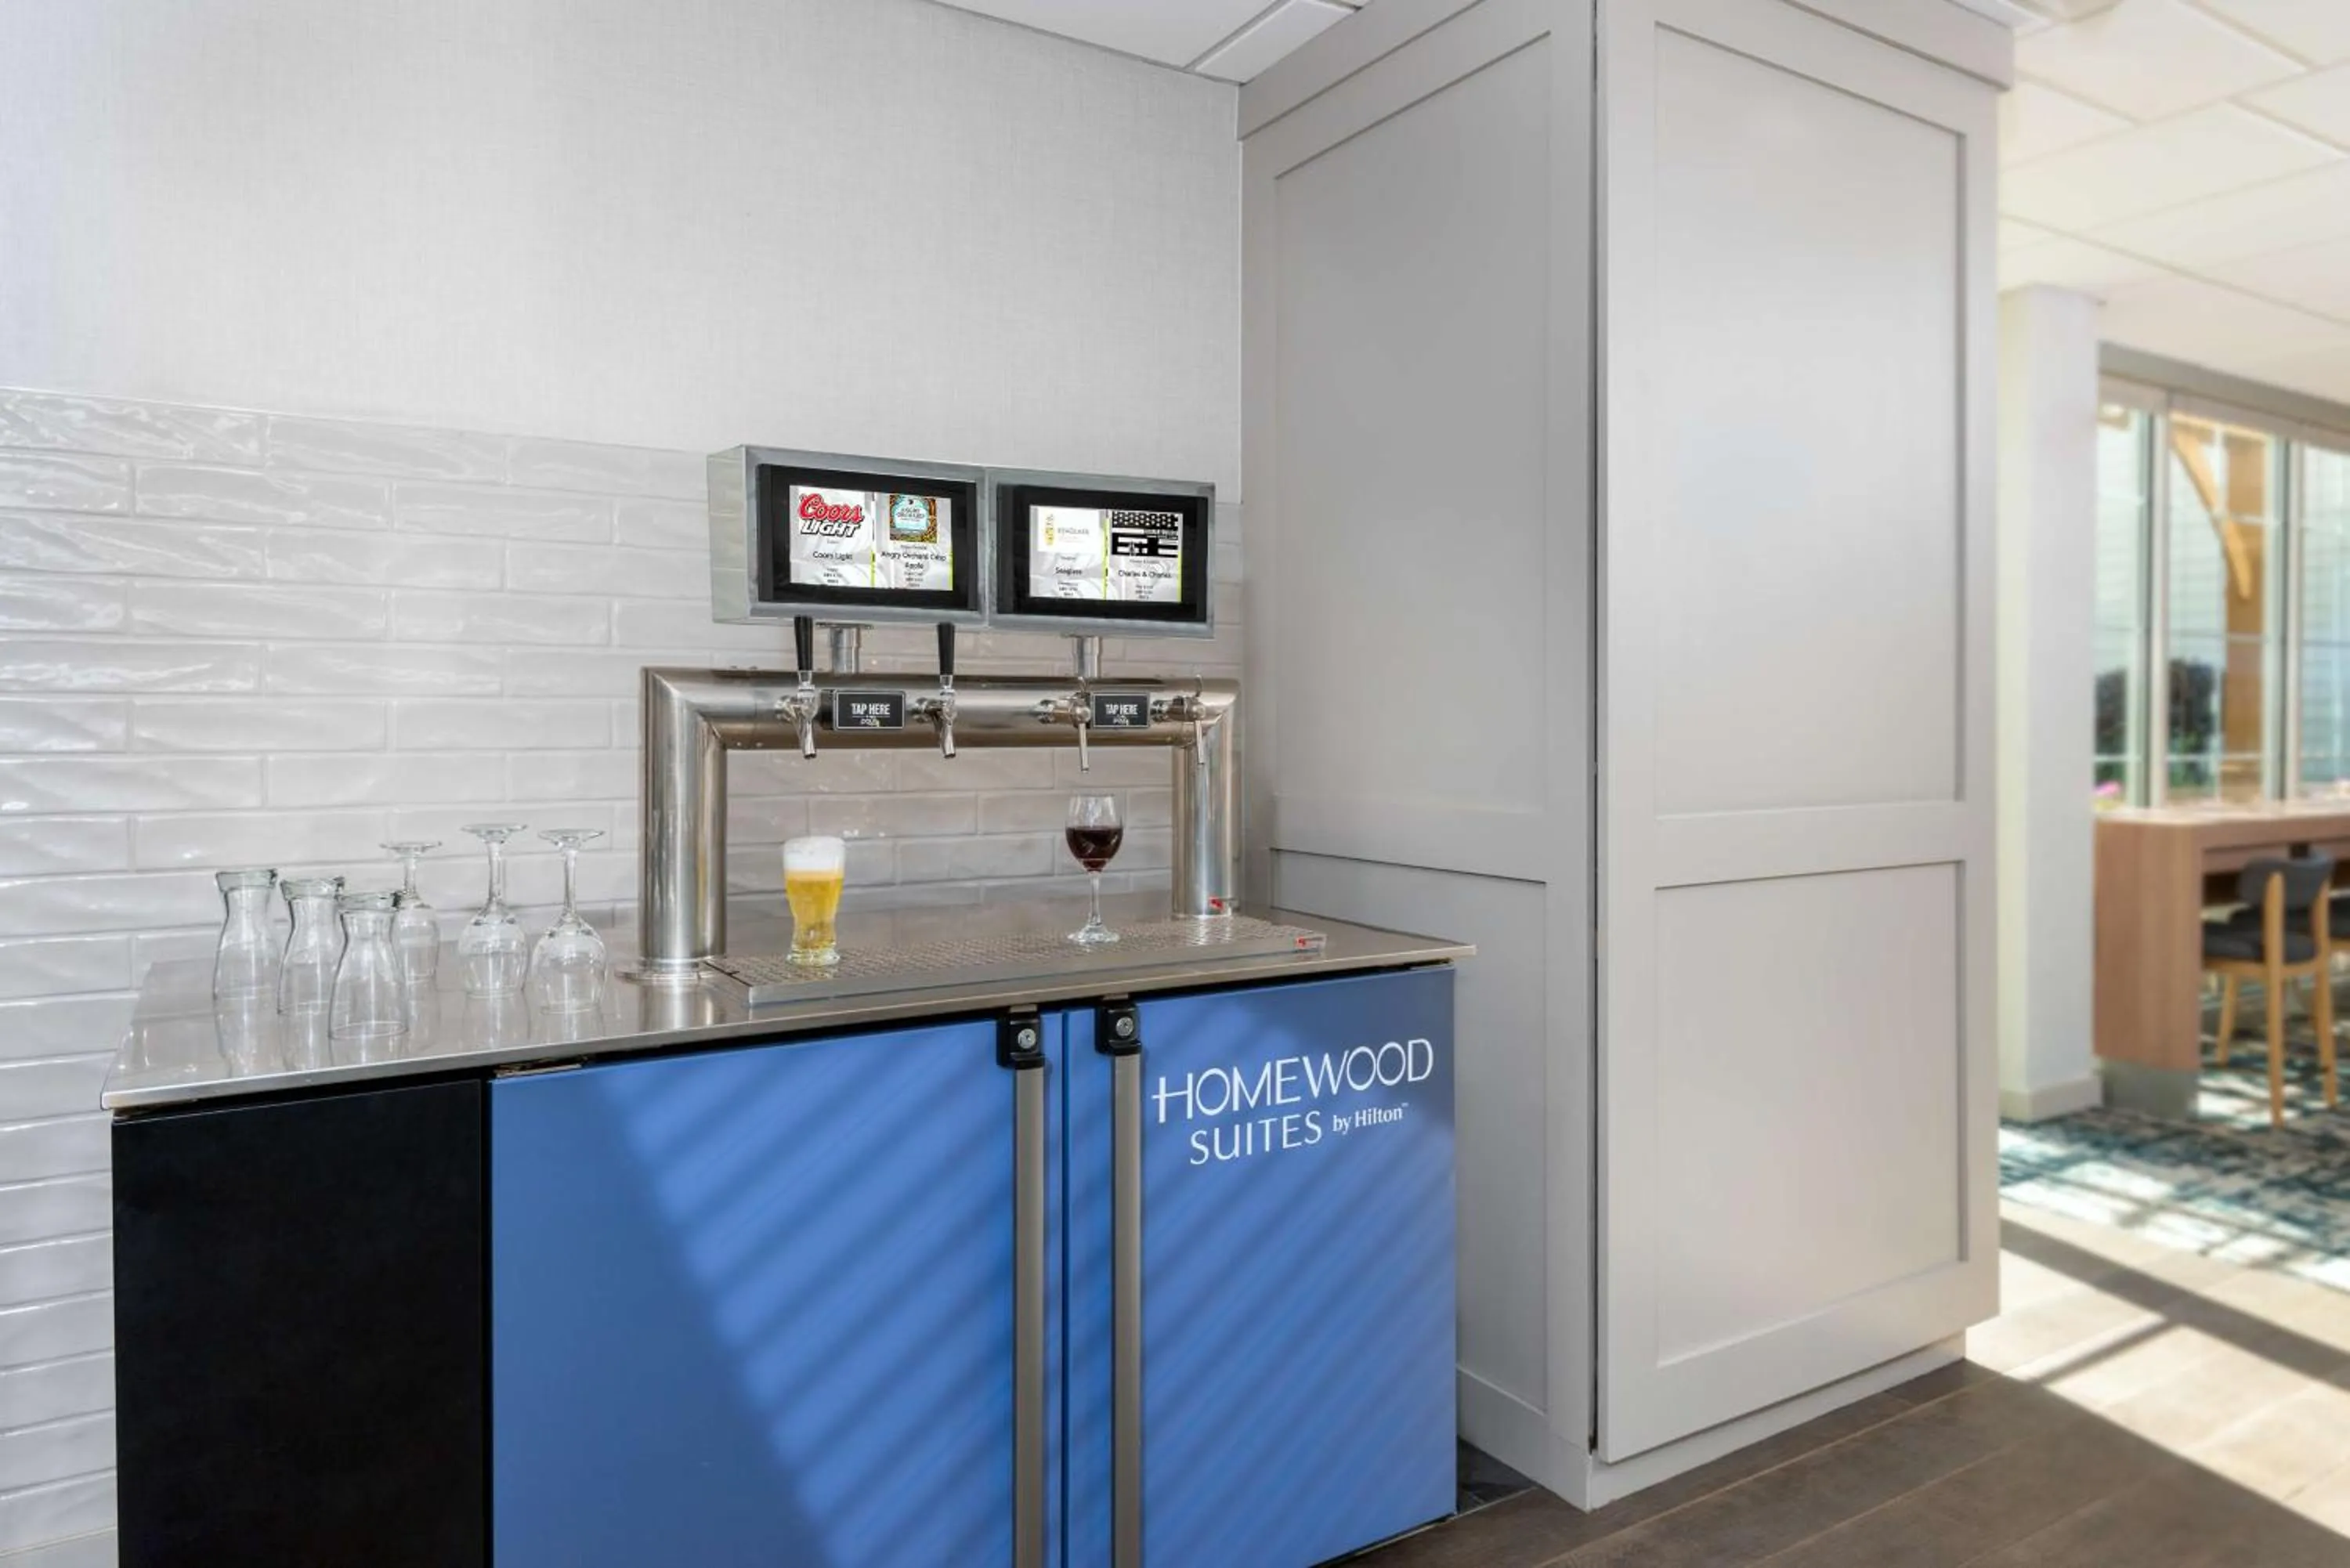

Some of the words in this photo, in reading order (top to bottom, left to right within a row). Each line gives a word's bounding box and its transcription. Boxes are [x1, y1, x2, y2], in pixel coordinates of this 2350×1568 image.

[798, 493, 865, 524] Coors
[801, 518, 861, 538] LIGHT
[835, 551, 853, 561] Light
[881, 551, 901, 560] Angry
[851, 703, 867, 714] TAP
[869, 703, 890, 715] HERE
[1105, 704, 1119, 714] TAP
[1119, 704, 1138, 714] HERE
[1152, 1039, 1434, 1123] HOMEWOOD
[1190, 1111, 1322, 1165] SUITES
[1332, 1115, 1352, 1135] by
[1355, 1107, 1404, 1128] Hilton
